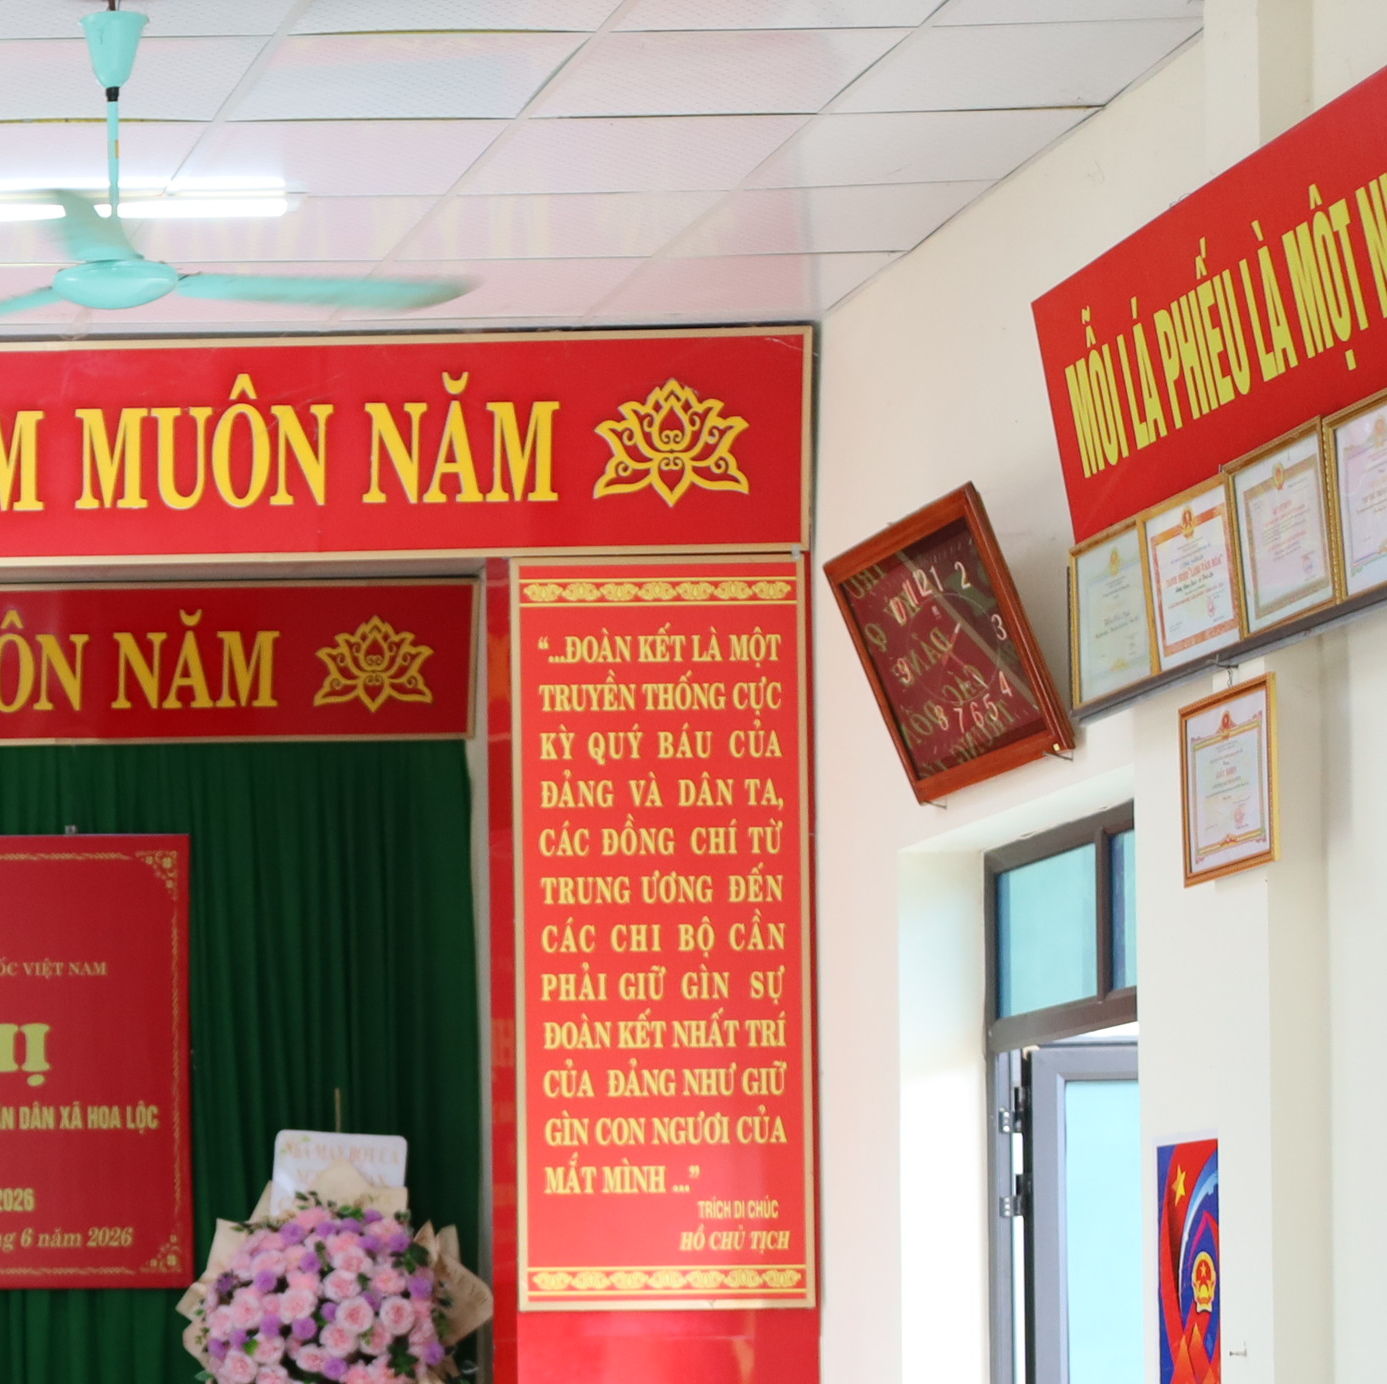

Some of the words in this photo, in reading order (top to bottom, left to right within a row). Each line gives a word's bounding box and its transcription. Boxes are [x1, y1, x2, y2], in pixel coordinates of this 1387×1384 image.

[1065, 306, 1129, 478] MỖI
[1116, 297, 1168, 450] LÁ
[1153, 237, 1251, 430] PHIẾU
[1238, 220, 1298, 382] LÀ
[1281, 184, 1369, 371] MỘT
[75, 374, 334, 510] MUÔN
[362, 372, 560, 504] NĂM
[929, 566, 943, 591] 1
[955, 561, 971, 589] 2
[991, 614, 1006, 640] 3
[637, 622, 686, 663] KẾT
[691, 626, 723, 662] LÀ
[729, 626, 781, 668] MỘT
[111, 609, 280, 709] NĂM
[538, 669, 636, 712] TRUYỀN
[641, 670, 726, 711] THỐNG
[732, 676, 782, 715] CỰC
[999, 671, 1012, 696] 4
[935, 705, 948, 731] 8
[970, 702, 984, 727] 6
[983, 693, 998, 720] 5
[953, 708, 964, 733] 7
[540, 724, 575, 760] KỲ
[588, 723, 643, 765] QUÝ
[657, 722, 713, 759] BÁU
[729, 719, 782, 758] CỦA
[541, 769, 614, 808] ĐẢNG
[628, 771, 663, 807] VÀ
[678, 771, 734, 807] DÂN
[744, 778, 784, 810] TA,
[19, 1101, 56, 1130] DÂN
[59, 1101, 83, 1130] XÃ
[87, 1105, 122, 1129] HOA
[126, 1100, 159, 1134] LỘC
[697, 1196, 732, 1219] TRÍCH
[733, 1200, 745, 1219] DI
[745, 1195, 779, 1219] CHÚC
[20, 1228, 34, 1248] 6
[37, 1228, 82, 1248] năm
[86, 1227, 133, 1247] 2026
[749, 1230, 790, 1254] TỊCH
